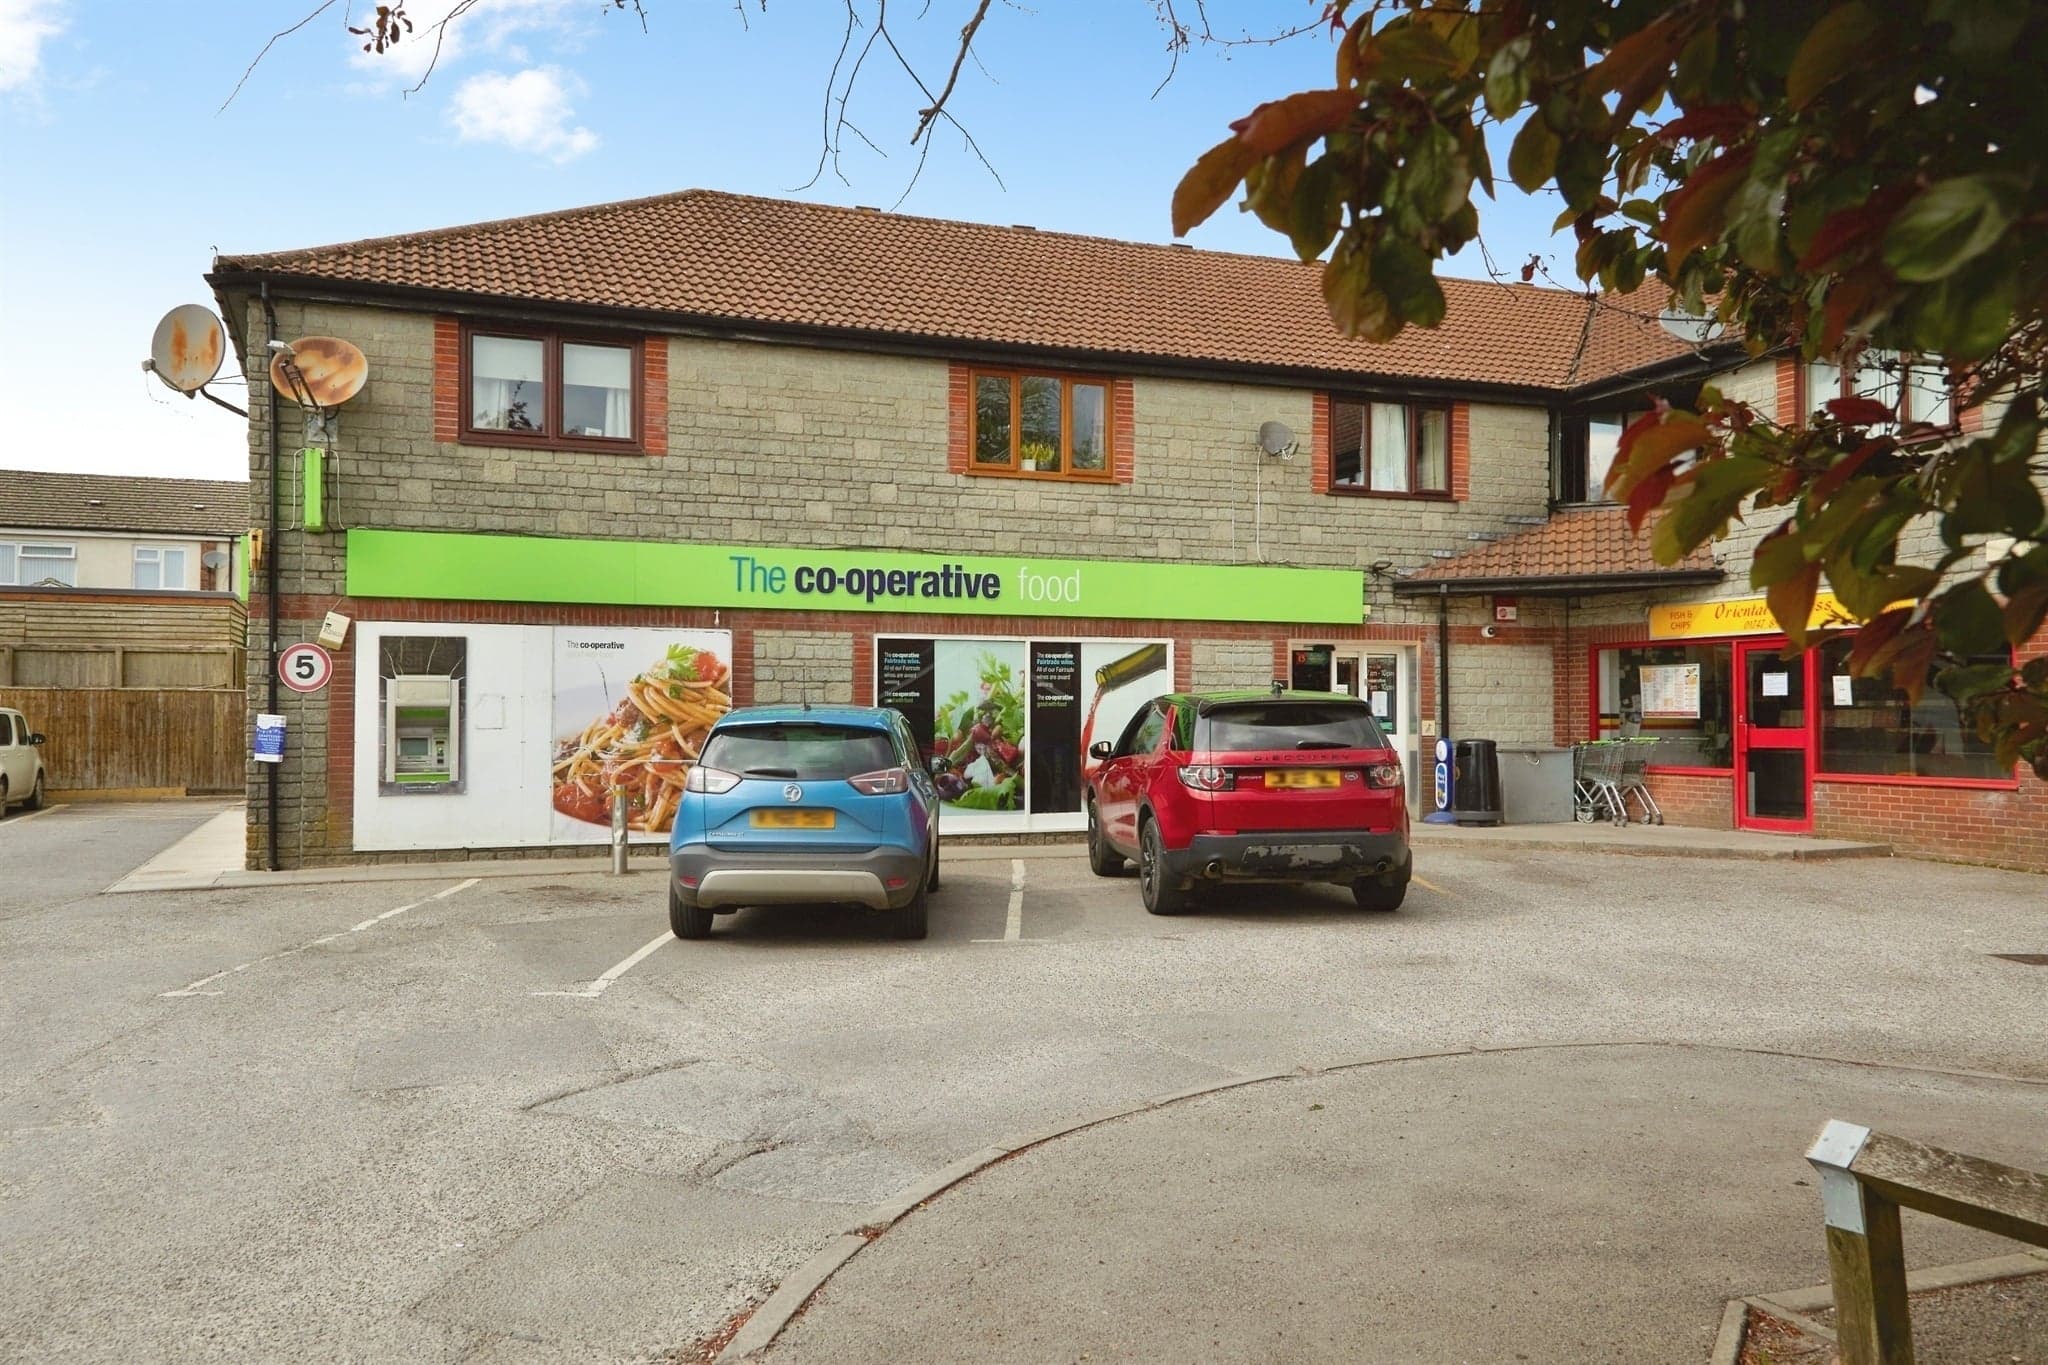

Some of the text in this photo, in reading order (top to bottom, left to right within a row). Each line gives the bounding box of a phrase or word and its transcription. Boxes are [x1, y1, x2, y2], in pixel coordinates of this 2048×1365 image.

[729, 555, 1081, 603] The co-operative food
[1670, 611, 1686, 620] FISH
[1670, 621, 1691, 630] CHIPS
[566, 640, 625, 650] The co-operative
[295, 655, 315, 680] 5
